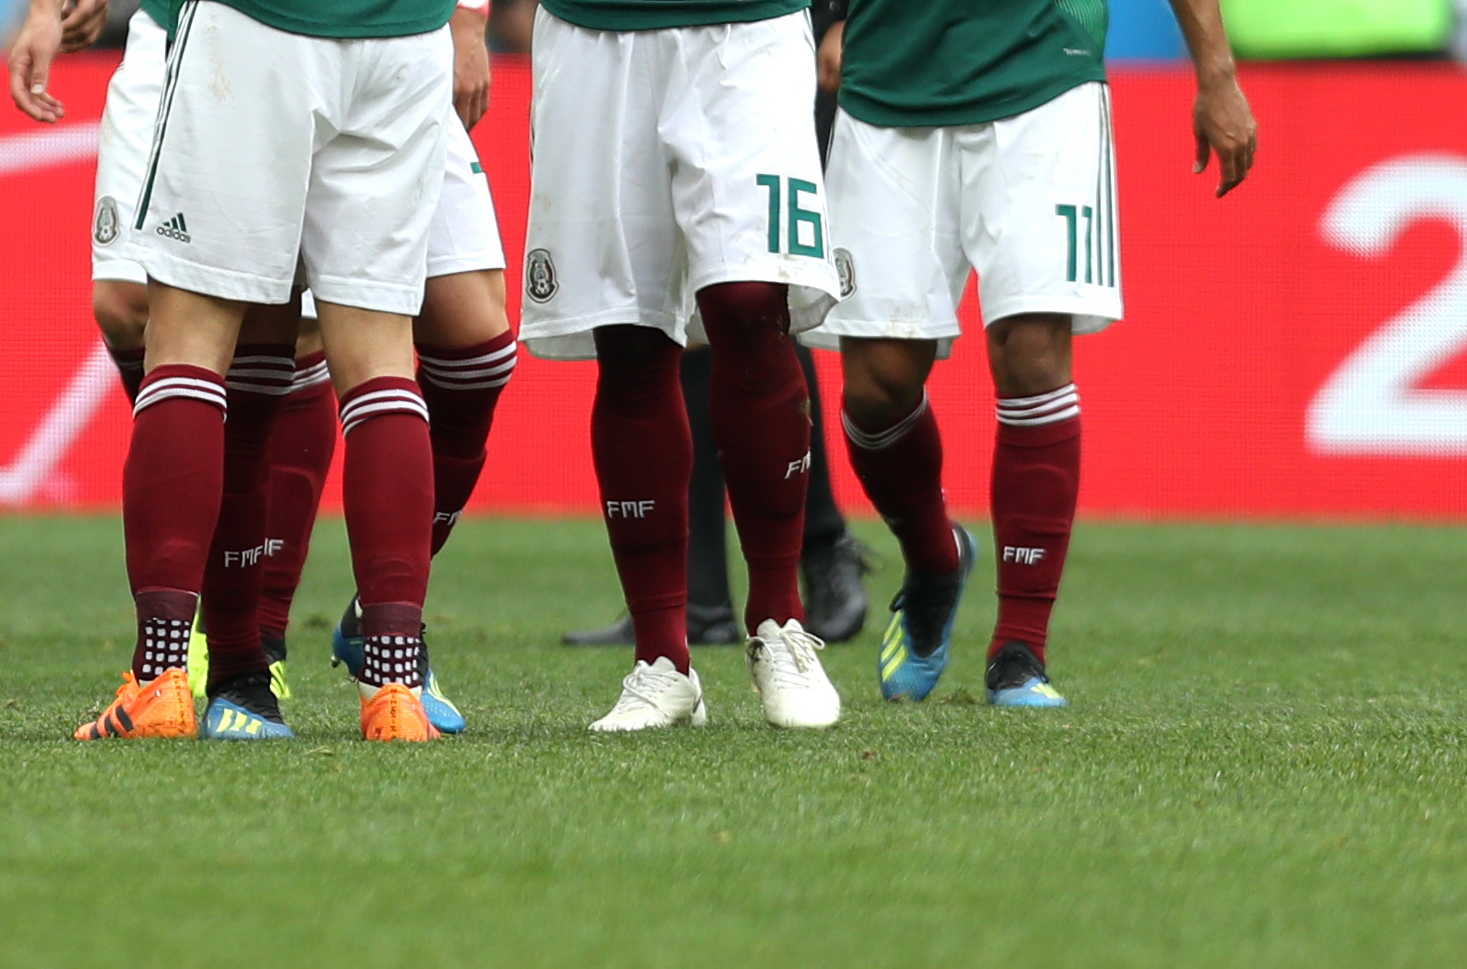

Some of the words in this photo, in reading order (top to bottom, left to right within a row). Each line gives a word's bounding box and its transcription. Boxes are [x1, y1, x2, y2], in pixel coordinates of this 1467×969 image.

[756, 173, 825, 260] 16
[156, 226, 192, 244] adidas
[1055, 203, 1093, 284] 11
[606, 499, 656, 519] FMF
[224, 545, 264, 568] FMF
[1003, 545, 1046, 565] FMF
